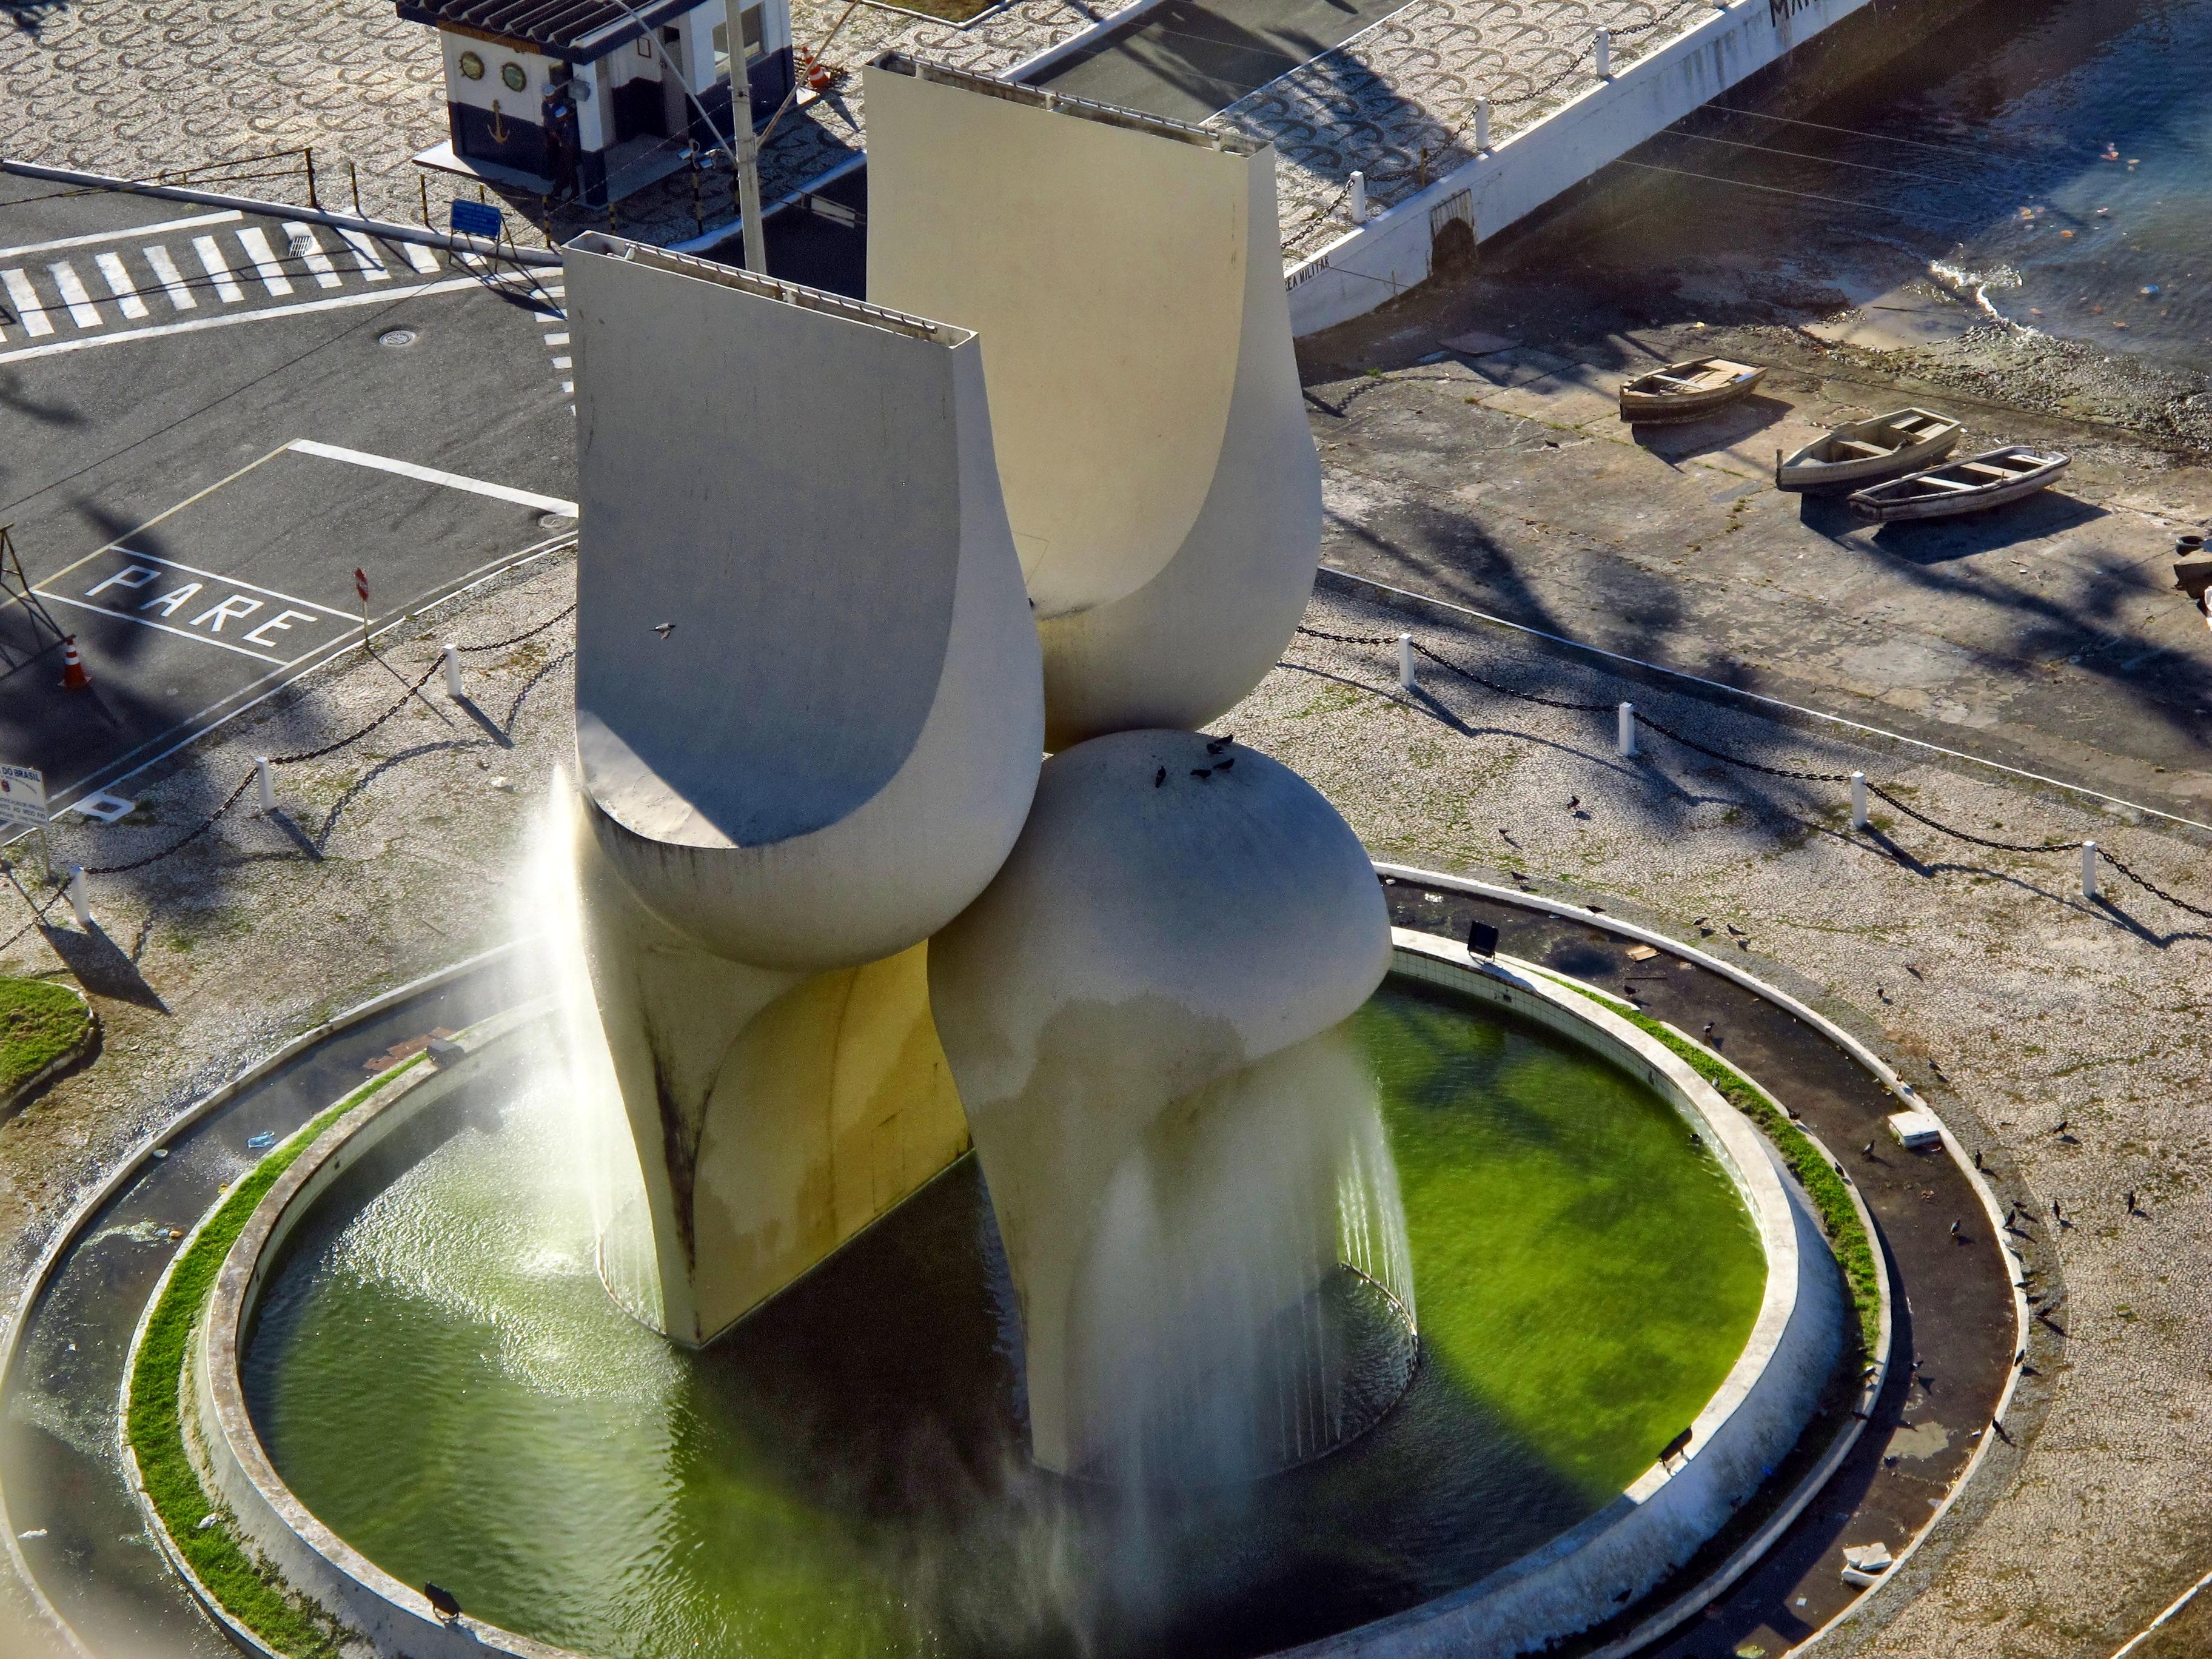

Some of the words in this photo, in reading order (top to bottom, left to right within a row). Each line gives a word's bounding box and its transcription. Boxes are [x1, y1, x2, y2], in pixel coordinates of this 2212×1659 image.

[1299, 255, 1330, 283] MILITAR
[84, 565, 318, 648] PARE
[2, 766, 13, 776] DO
[13, 768, 41, 782] BRASIL
